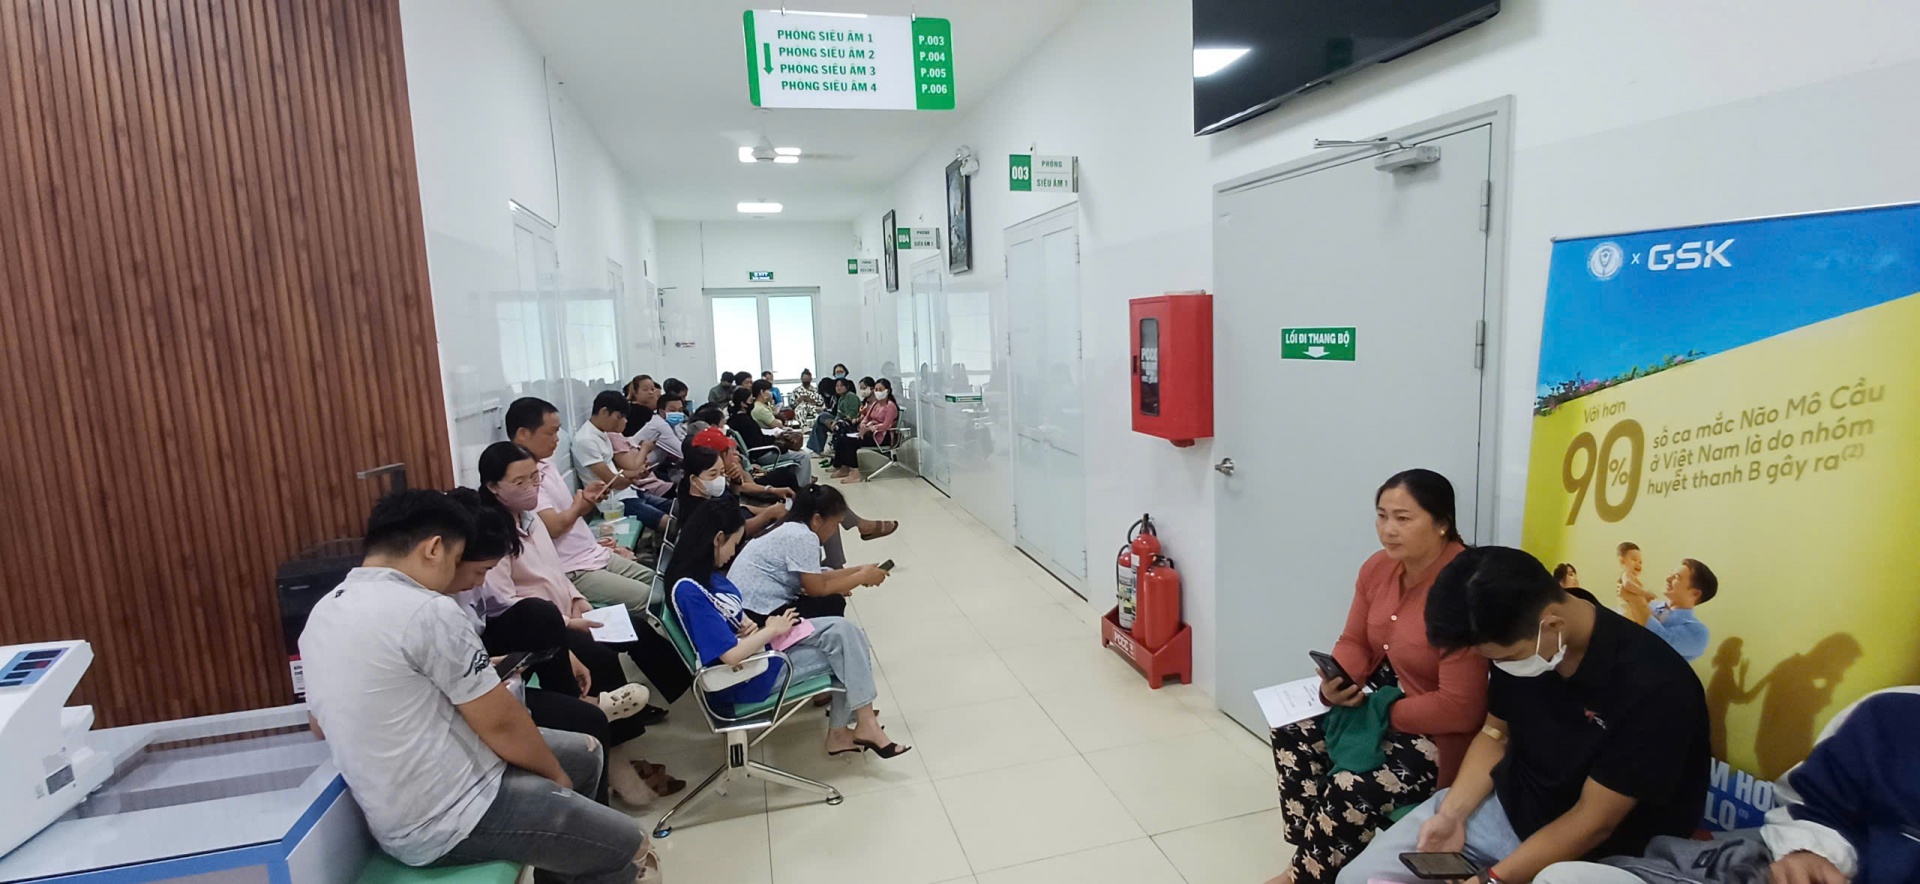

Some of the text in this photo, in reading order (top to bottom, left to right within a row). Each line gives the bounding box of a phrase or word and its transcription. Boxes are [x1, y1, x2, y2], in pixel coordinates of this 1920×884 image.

[777, 28, 873, 43] PHÒNG SIÊU ÂM 1
[918, 35, 945, 46] P.003
[778, 45, 875, 59] PHÒNG SIÊU ÂM 2
[920, 52, 946, 62] P.004
[780, 61, 876, 76] PHÒNG SIÊU ÂM 3
[920, 68, 947, 78] P.005
[782, 79, 877, 92] PHÒNG SIÊU ÂM 4
[922, 84, 948, 94] P.006
[1011, 166, 1029, 180] 003
[1648, 238, 1735, 271] GSK
[1286, 330, 1298, 344] LỐI
[1308, 333, 1336, 344] THANG
[1338, 330, 1350, 348] BỘ
[1584, 401, 1626, 423] Với hơn
[1653, 378, 1886, 449] số ca mắc Não Mô Cầu
[1698, 444, 1740, 464] Nam
[1745, 434, 1762, 455] là
[1767, 430, 1794, 452] do
[1800, 416, 1875, 446] nhóm
[1647, 468, 1688, 498] huyết
[1692, 464, 1743, 489] thanh
[1748, 460, 1761, 481] B
[1766, 454, 1808, 485] gây
